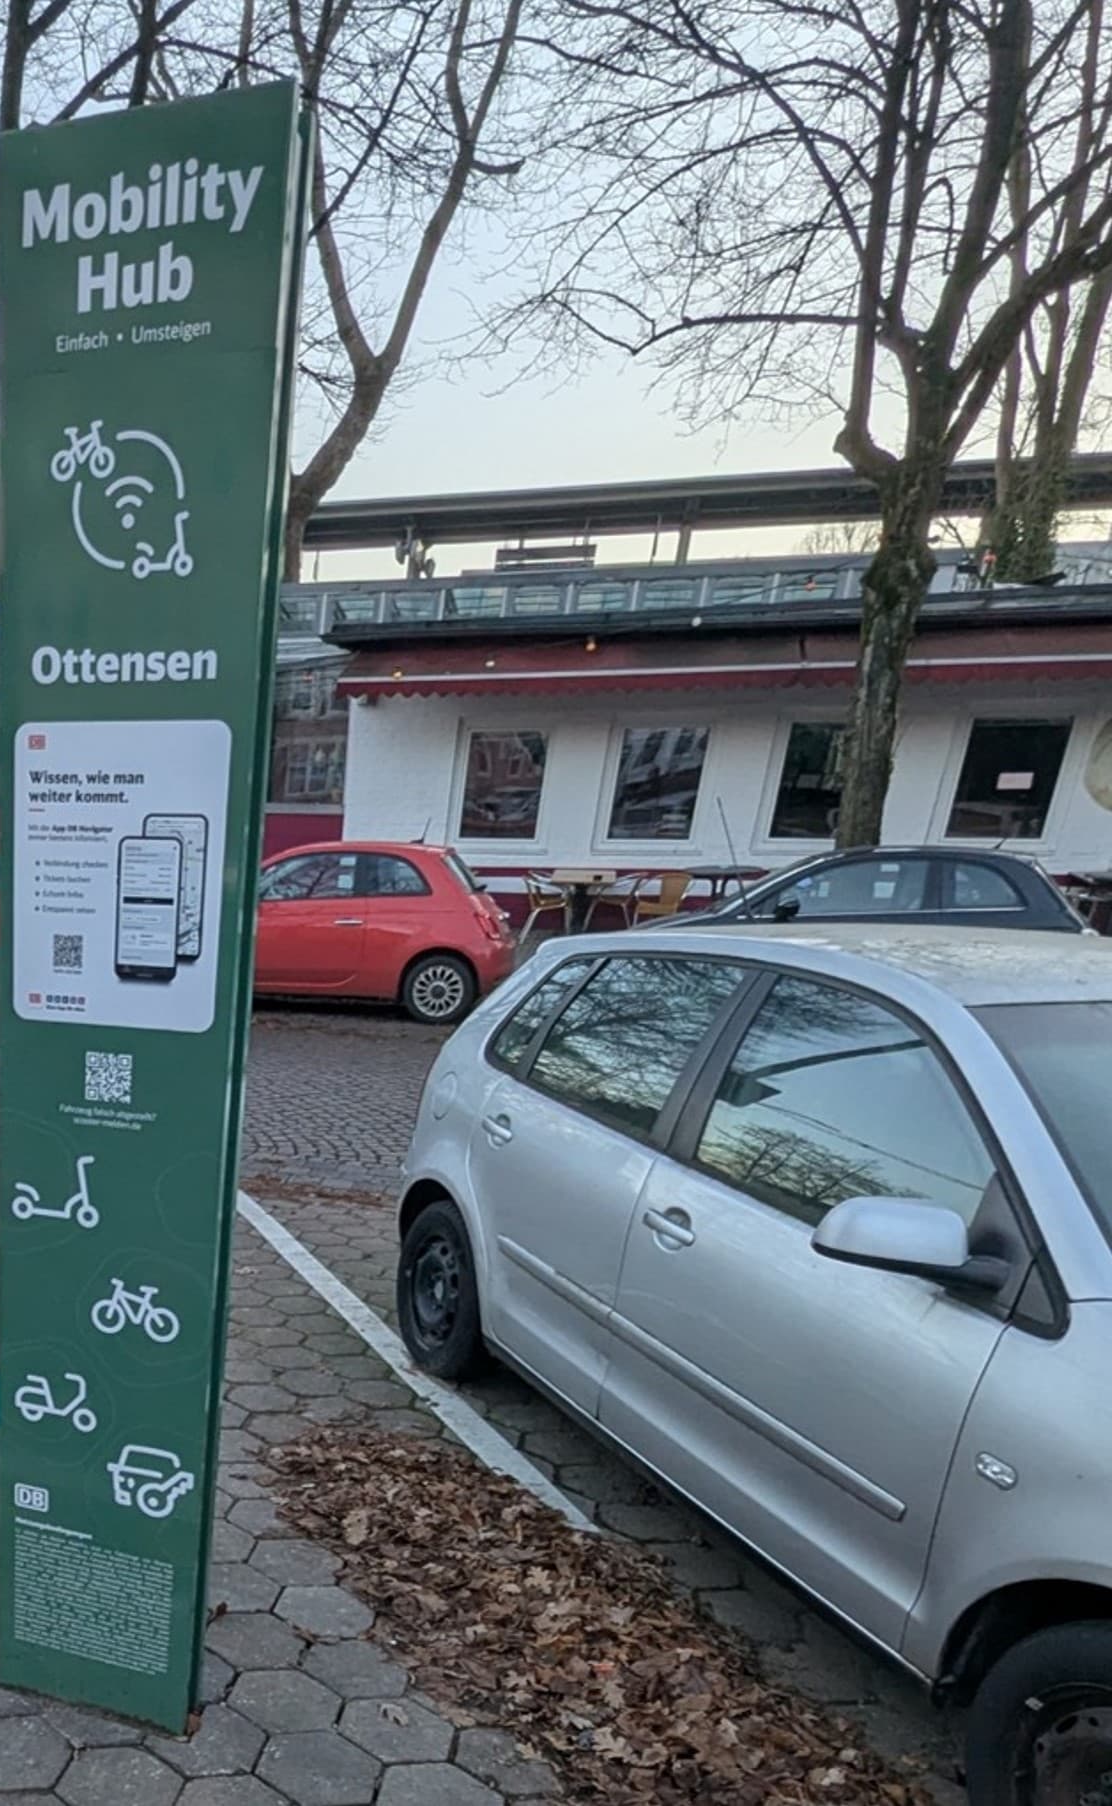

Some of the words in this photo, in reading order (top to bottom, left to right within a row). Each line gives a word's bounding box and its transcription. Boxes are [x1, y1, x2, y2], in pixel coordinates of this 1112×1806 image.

[22, 157, 265, 248] Mobility
[76, 241, 194, 314] Hub
[56, 329, 109, 352] Einfach
[131, 321, 211, 345] Umsteigen
[31, 646, 218, 685] Ottensen
[29, 770, 83, 786] Wissen,
[86, 770, 110, 784] wie
[113, 773, 145, 784] man
[28, 789, 72, 803] weiter
[75, 789, 129, 803] kommt.
[18, 1486, 45, 1509] DB
